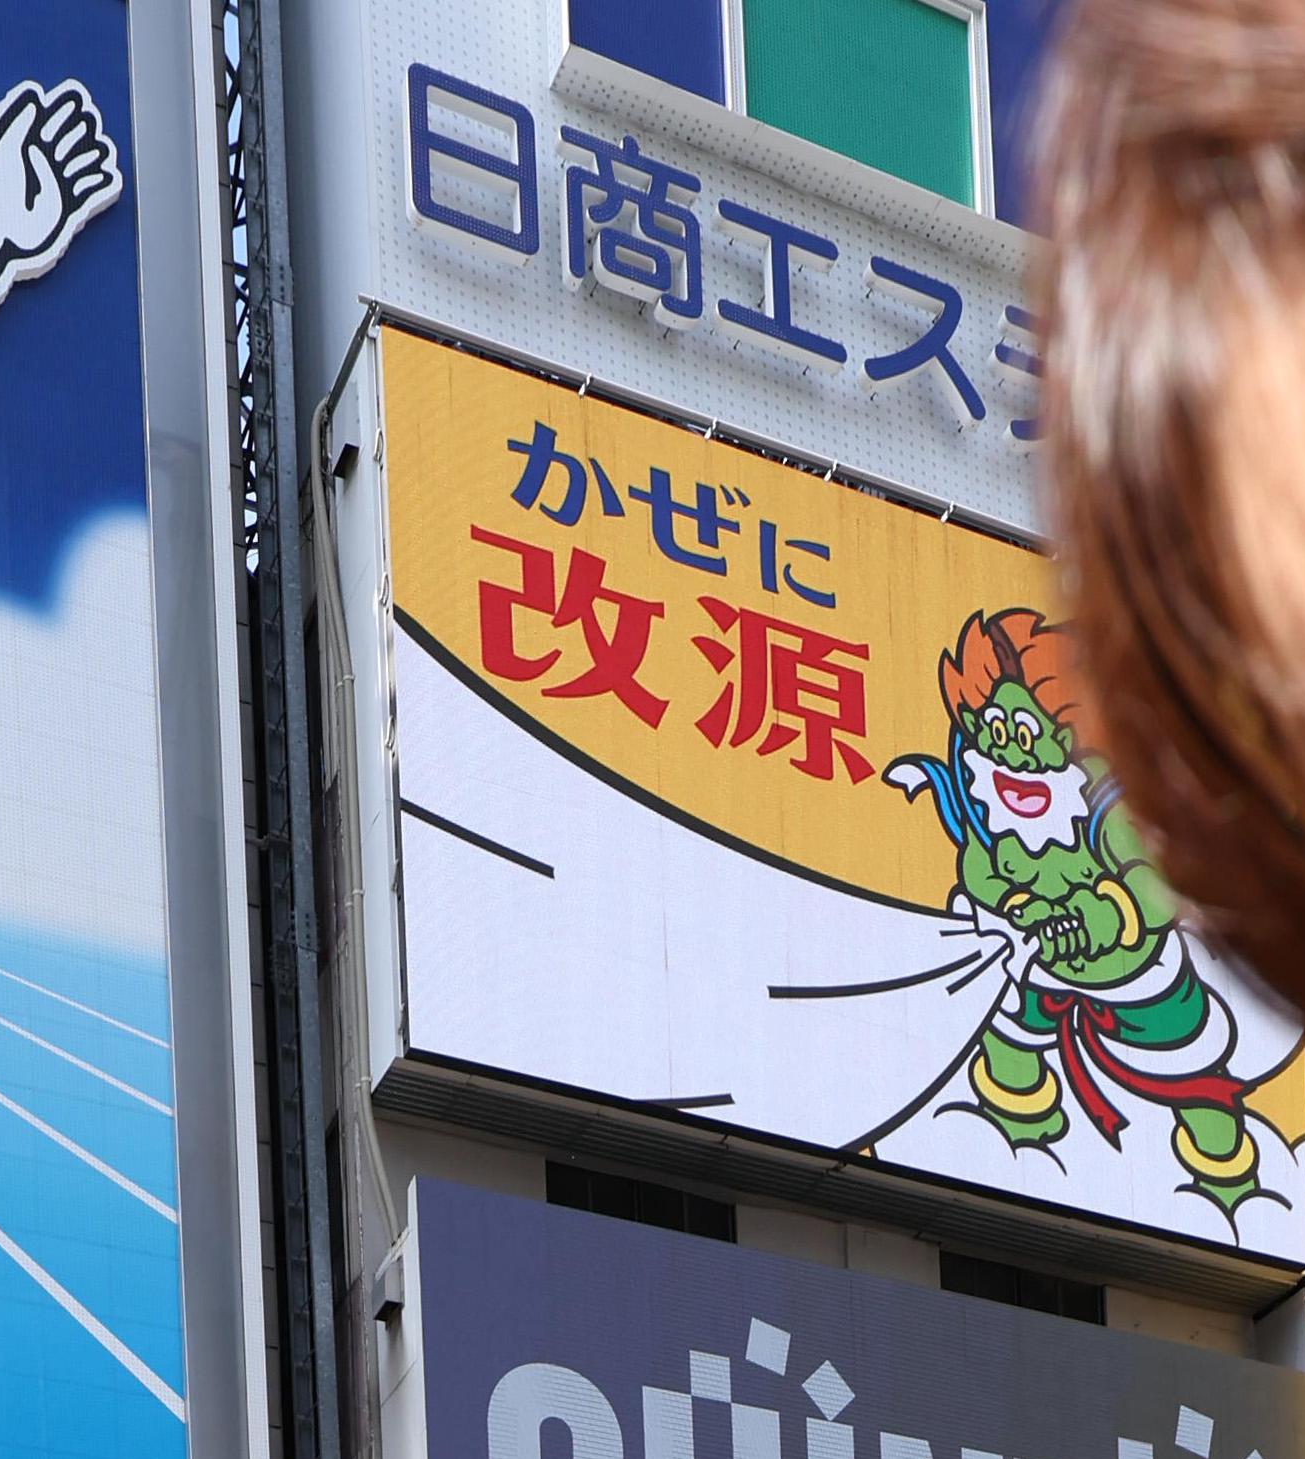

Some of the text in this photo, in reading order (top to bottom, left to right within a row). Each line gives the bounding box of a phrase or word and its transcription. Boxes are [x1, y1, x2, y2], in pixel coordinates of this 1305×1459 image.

[506, 419, 836, 610] かぜに
[470, 523, 878, 786] 改源
